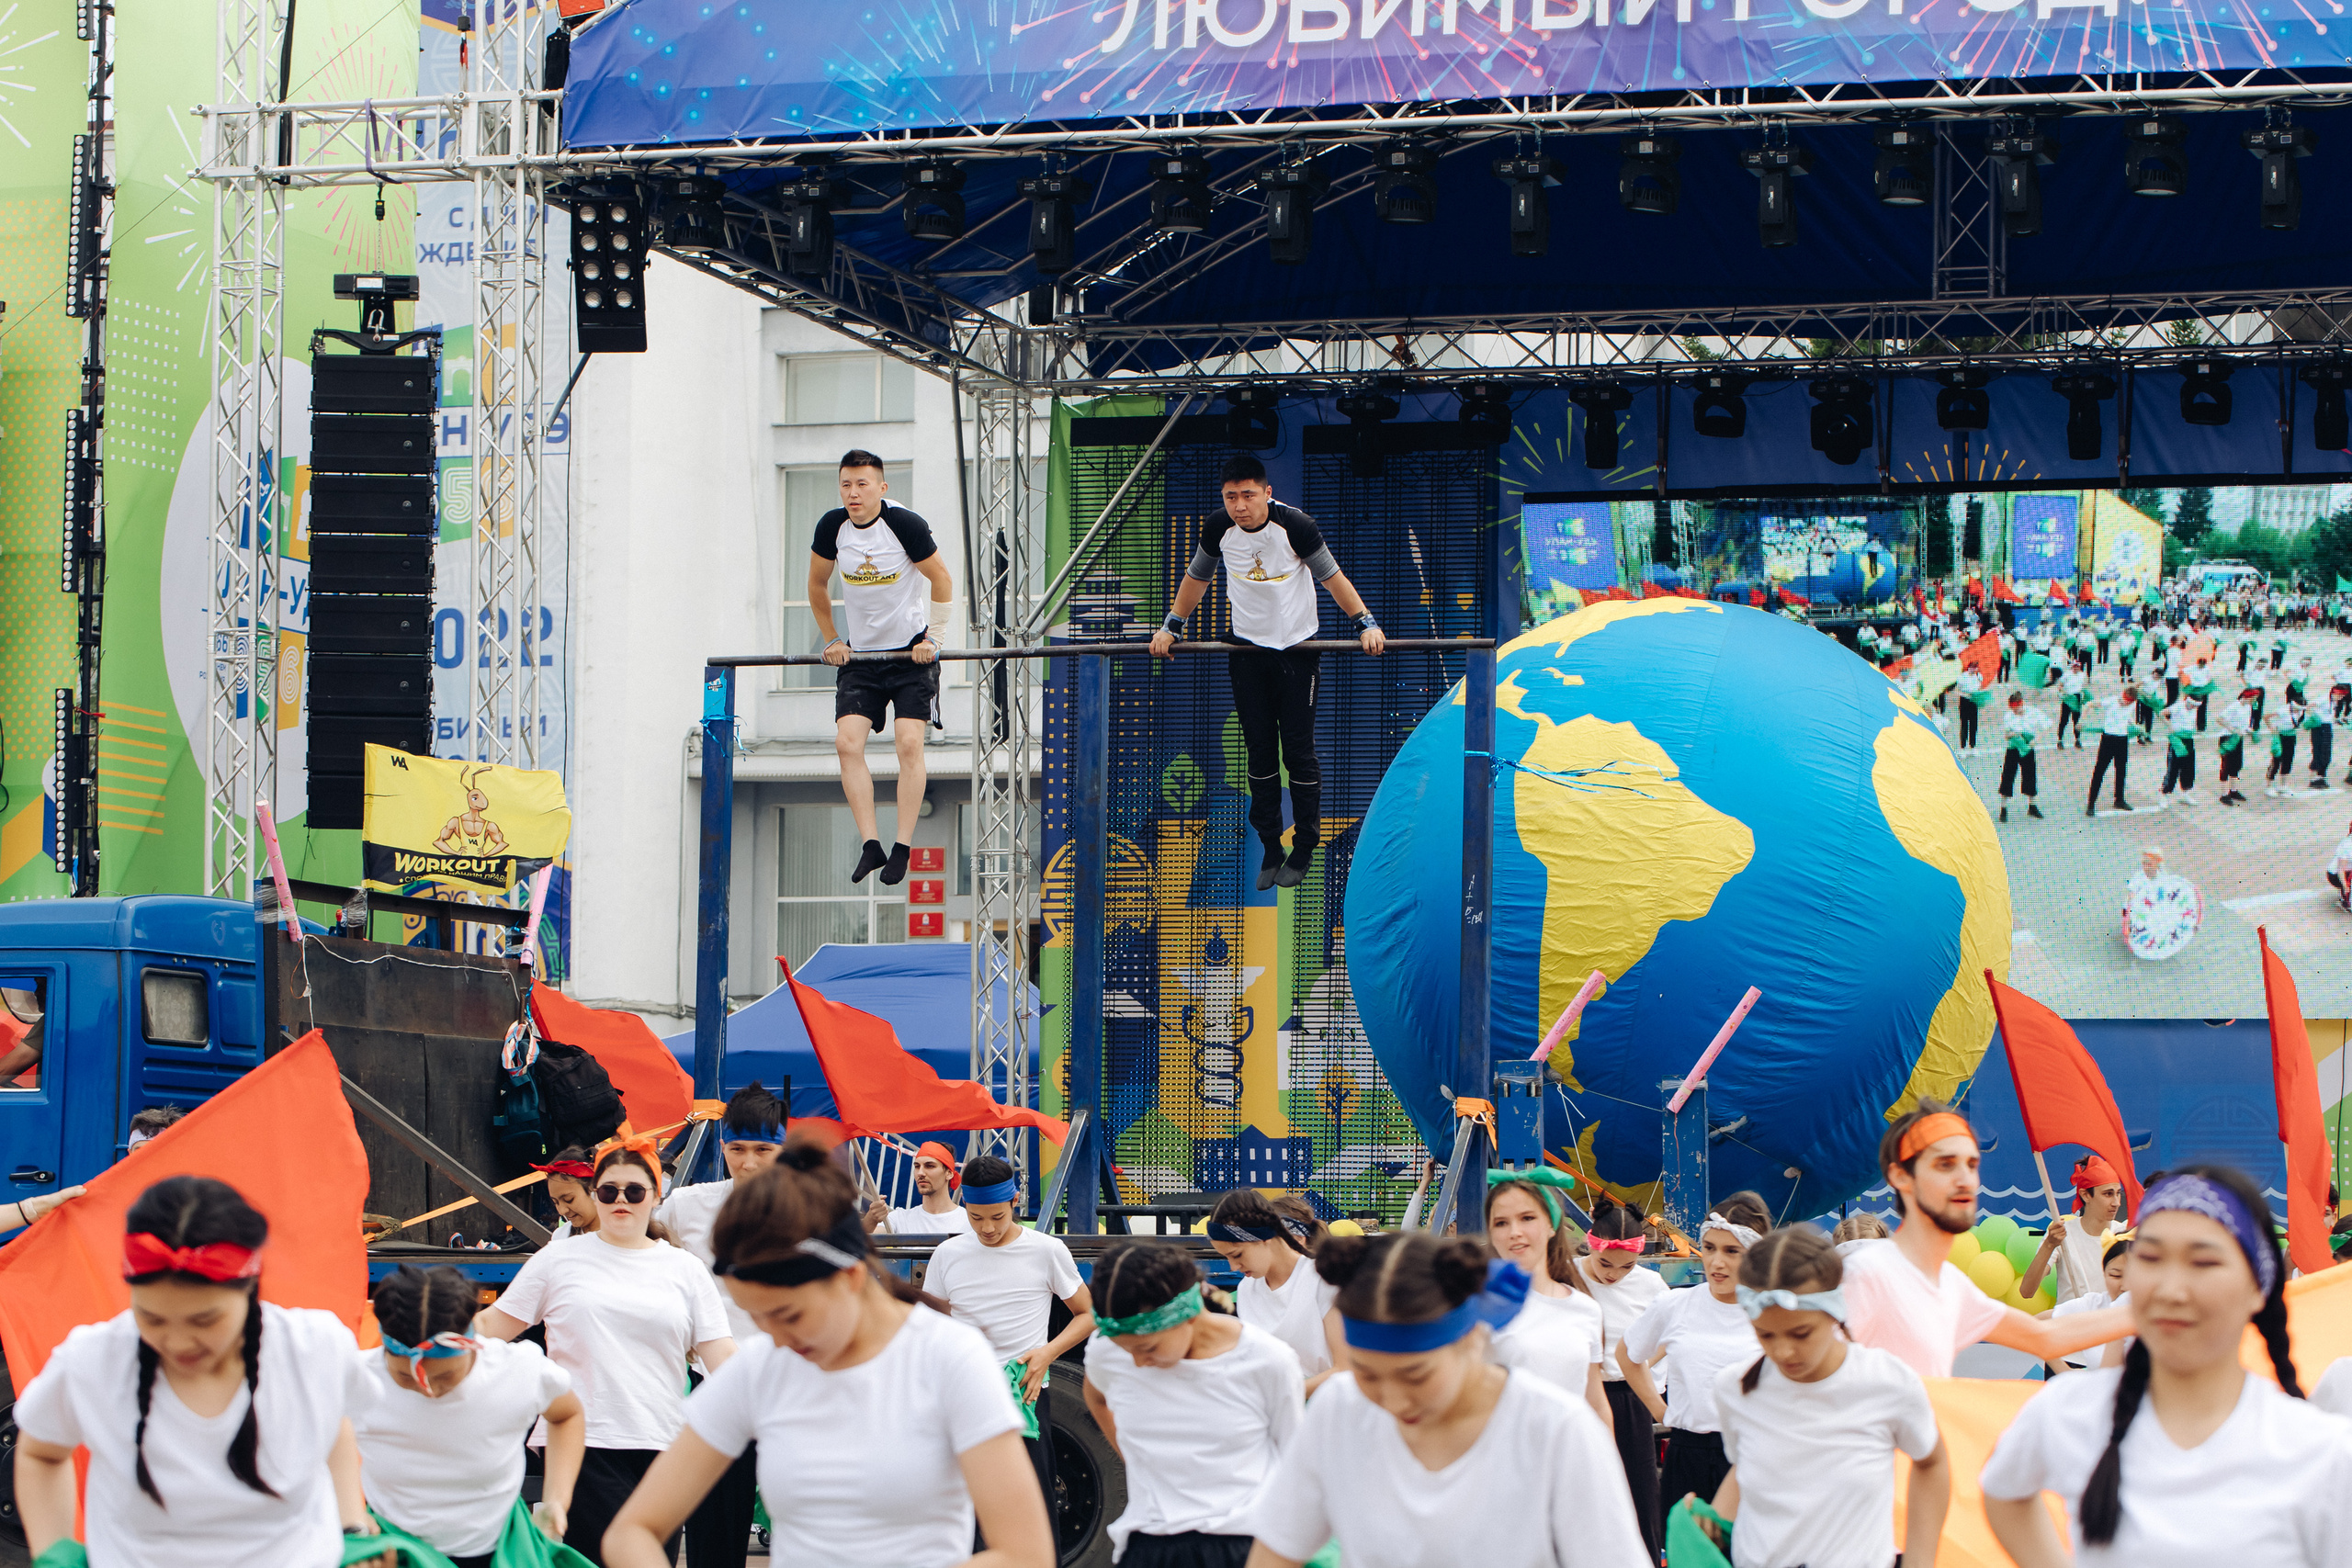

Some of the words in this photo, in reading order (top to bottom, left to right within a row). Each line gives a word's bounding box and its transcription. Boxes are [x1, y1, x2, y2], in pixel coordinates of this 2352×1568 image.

[843, 571, 878, 581] WORKOUT
[390, 754, 410, 771] WA
[394, 852, 501, 874] WORKOUT
